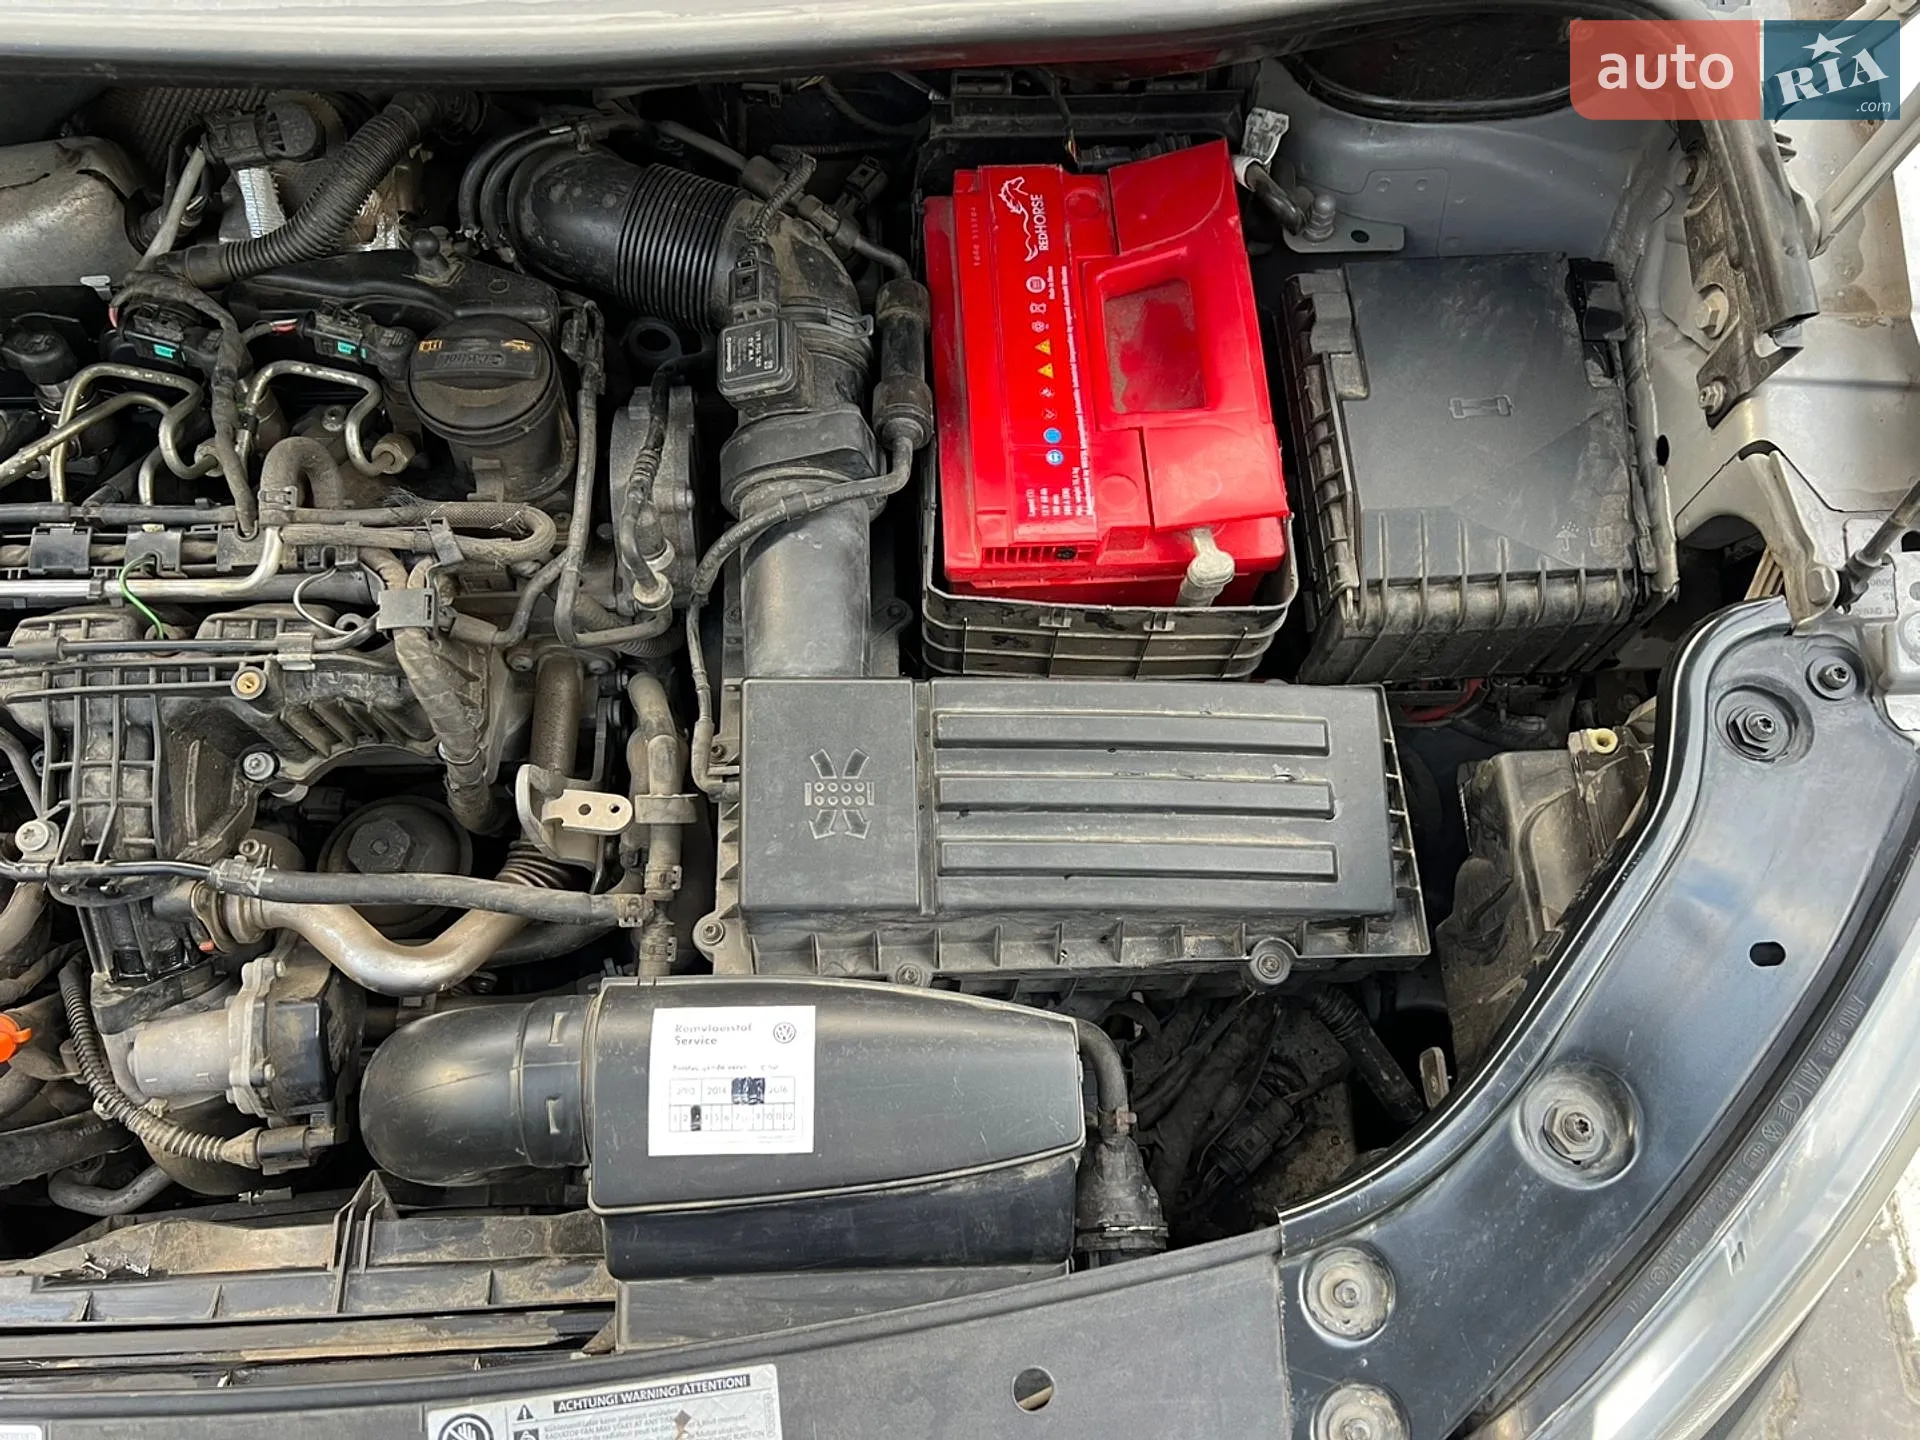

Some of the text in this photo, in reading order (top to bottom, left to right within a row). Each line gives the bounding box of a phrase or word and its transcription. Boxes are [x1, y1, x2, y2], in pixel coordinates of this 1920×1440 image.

[1030, 194, 1049, 251] REDHORSE
[675, 1036, 718, 1046] Service
[558, 1376, 747, 1412] ACHTUNG! WARNING! ATTENTION!
